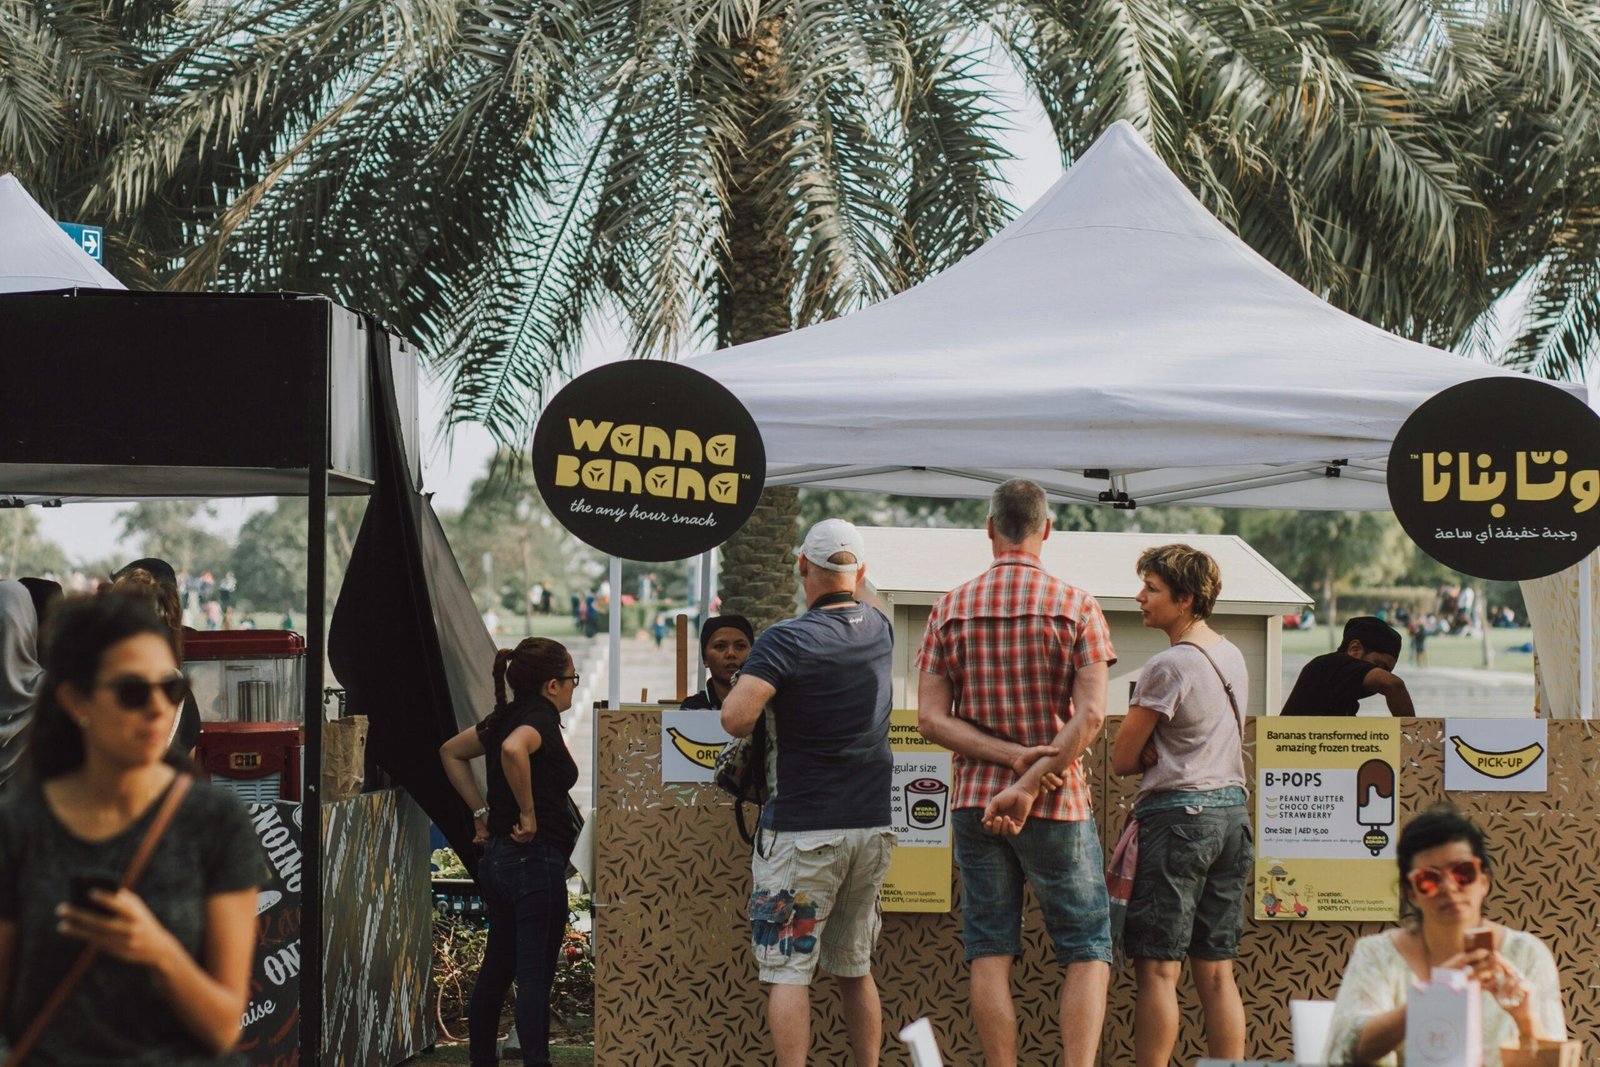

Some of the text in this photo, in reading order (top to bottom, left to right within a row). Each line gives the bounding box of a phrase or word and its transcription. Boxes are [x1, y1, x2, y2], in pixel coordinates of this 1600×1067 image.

[568, 418, 736, 466] wanna
[1422, 451, 1506, 518] بنانا
[570, 498, 717, 527] the any hour snack
[1435, 527, 1472, 539] ساعة
[1495, 526, 1539, 541] خفيفة
[1542, 527, 1577, 541] وجبة
[1267, 731, 1390, 740] Bananas transformed into
[1276, 742, 1382, 754] amazing frozen treats.
[920, 763, 937, 773] size
[1477, 757, 1523, 767] PICK-UP
[1265, 772, 1322, 787] B-POPS
[1265, 826, 1278, 834] One
[1279, 826, 1292, 834] Size
